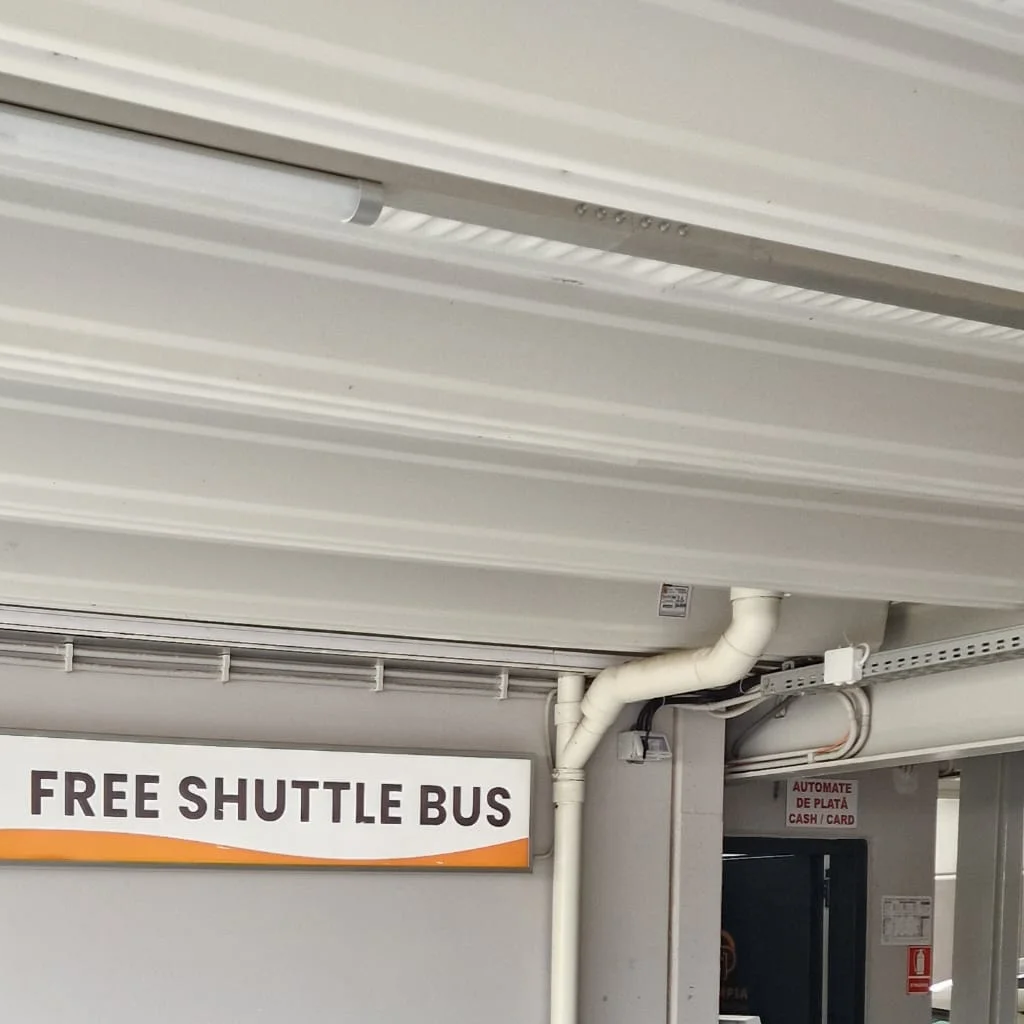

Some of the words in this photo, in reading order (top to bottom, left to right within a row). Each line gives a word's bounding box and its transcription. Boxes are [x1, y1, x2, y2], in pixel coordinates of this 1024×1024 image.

[792, 781, 852, 793] AUTOMATE
[31, 769, 160, 818] FREE
[178, 774, 403, 825] SHUTTLE
[420, 784, 512, 828] BUS
[796, 797, 811, 808] DE
[814, 796, 848, 809] PLATĂ
[789, 812, 817, 824] CASH
[826, 814, 855, 825] CARD
